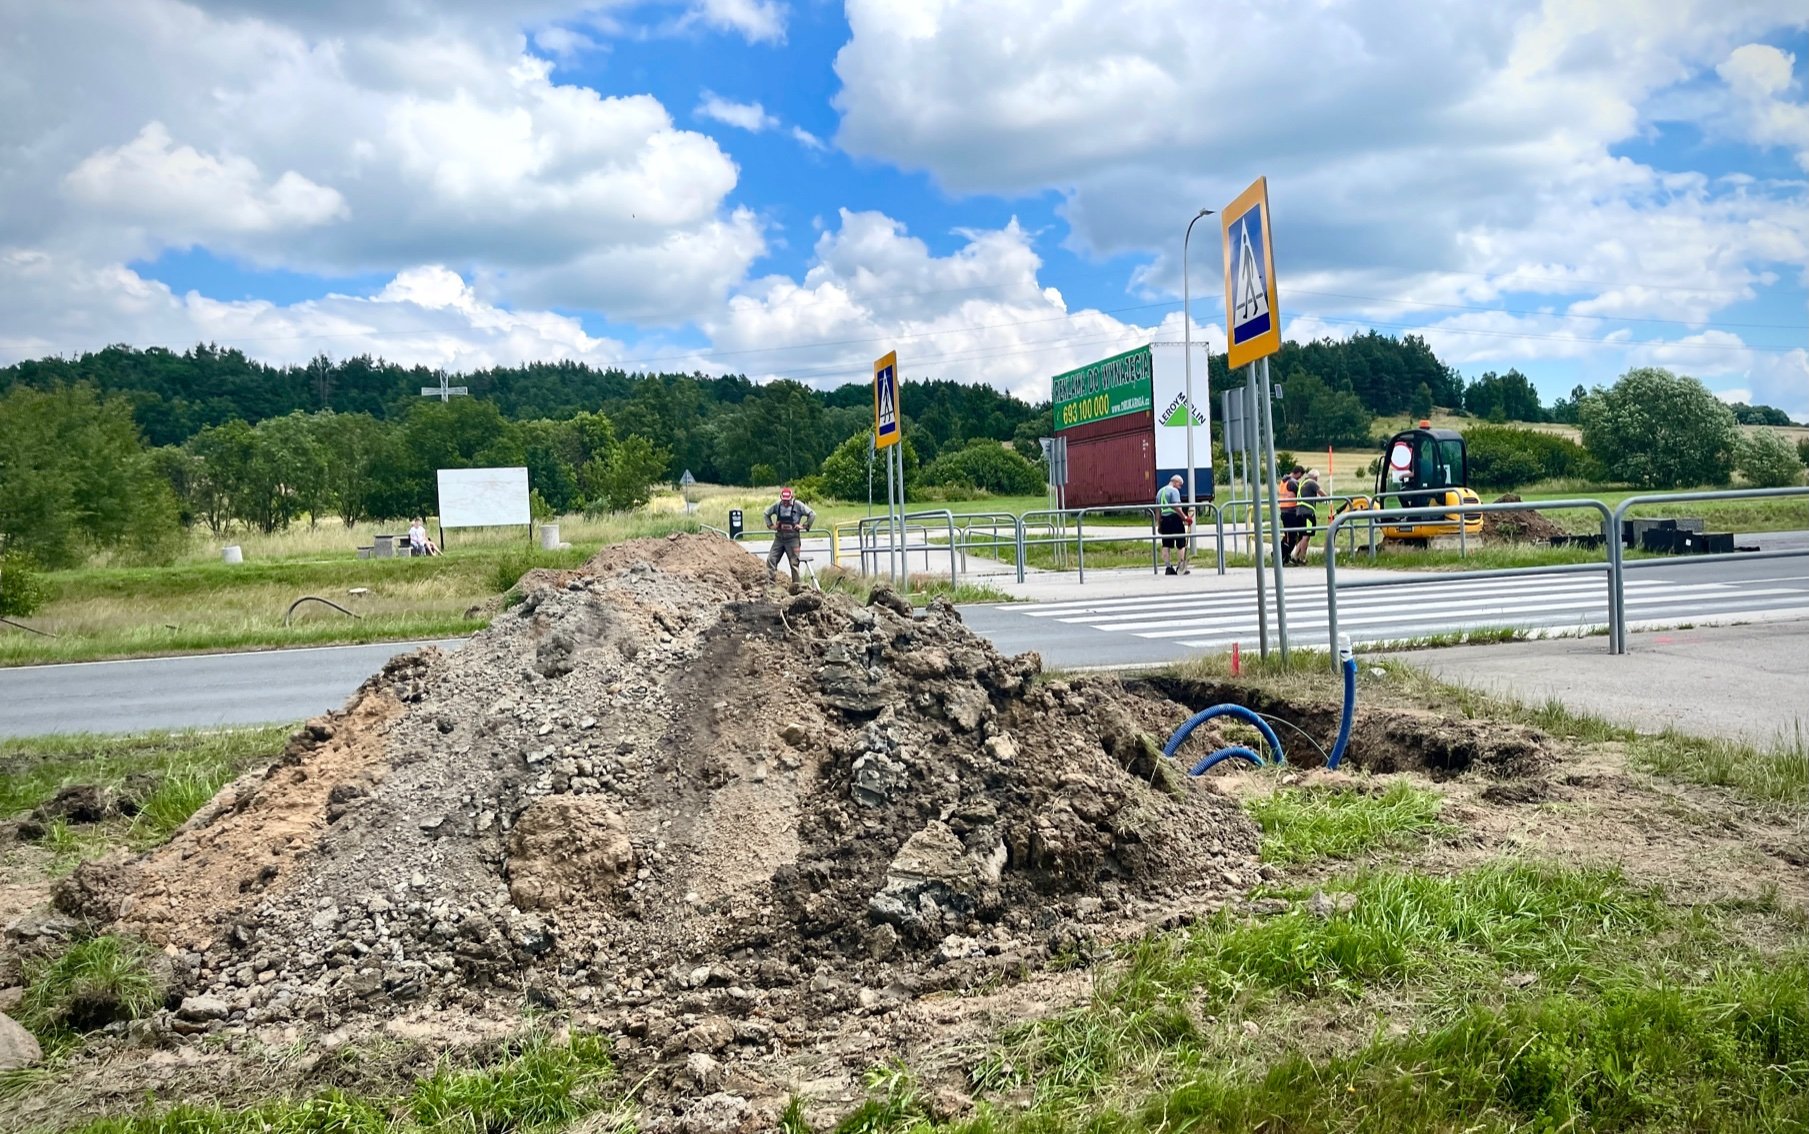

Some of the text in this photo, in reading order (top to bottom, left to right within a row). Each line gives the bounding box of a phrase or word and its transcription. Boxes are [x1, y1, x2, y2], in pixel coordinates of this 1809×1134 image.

[1054, 350, 1150, 404] REKLAMA DO WYNAJĘCIA
[1063, 393, 1110, 424] 693 100 000
[1158, 398, 1180, 425] LEROY
